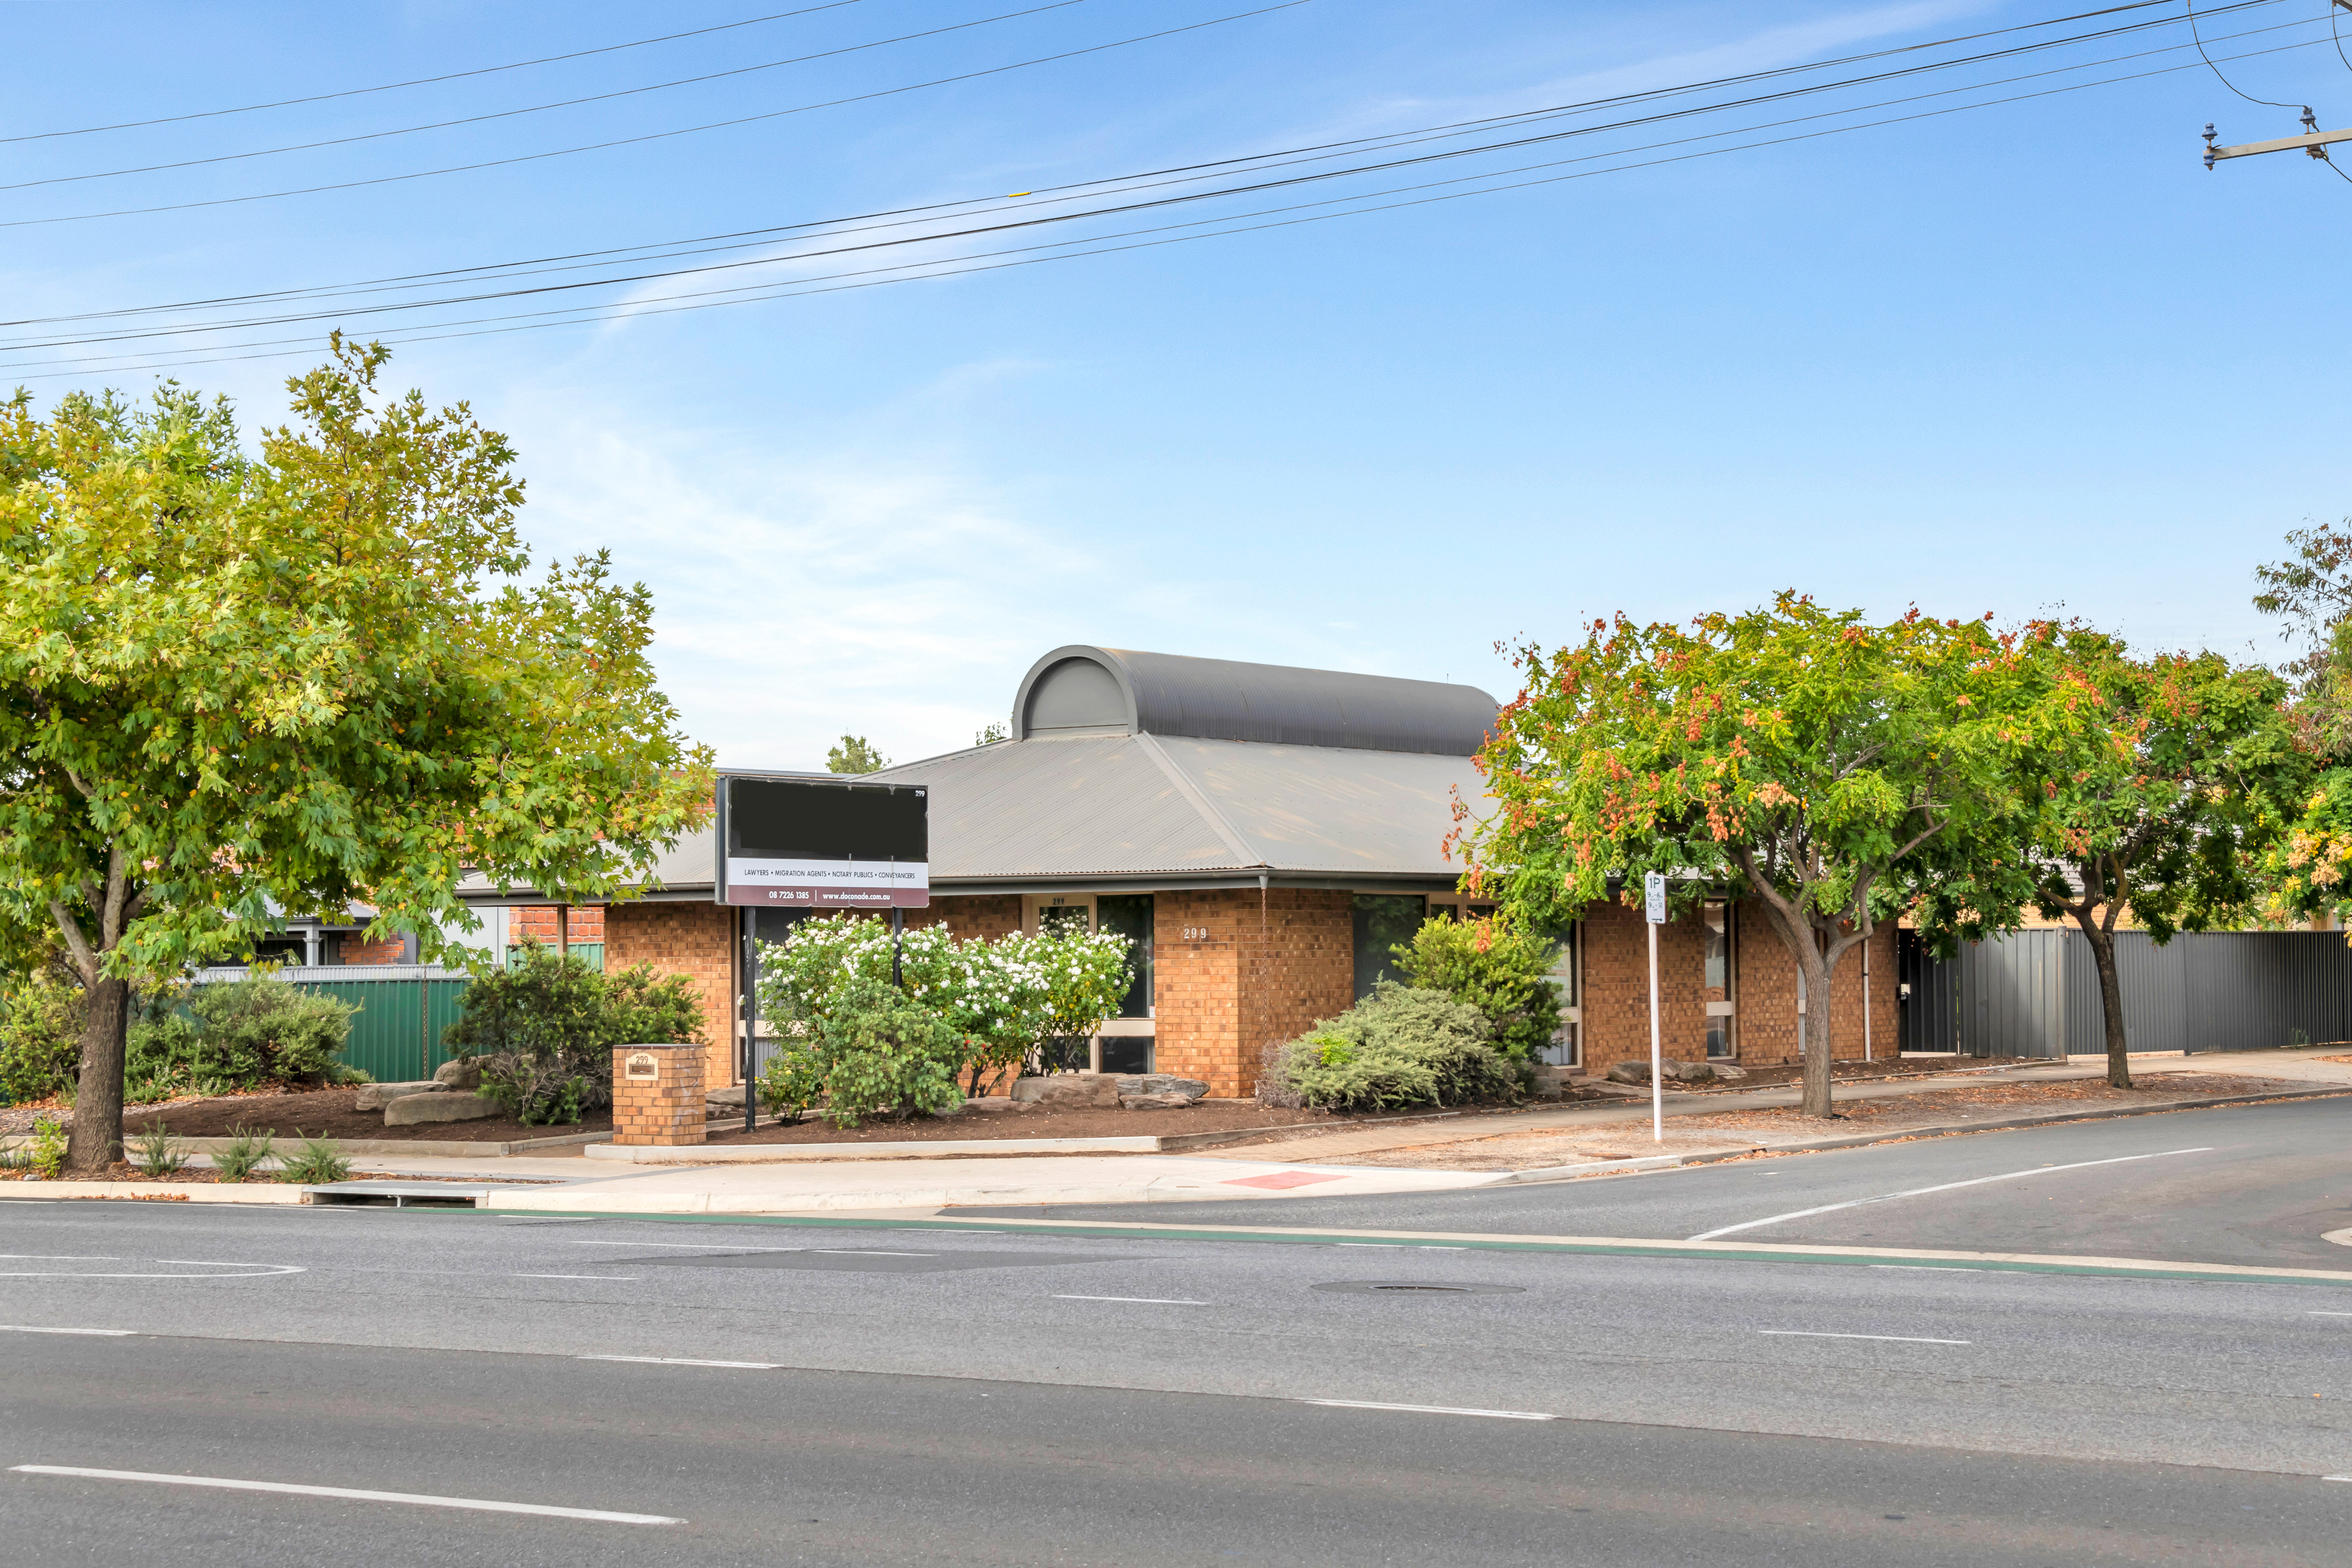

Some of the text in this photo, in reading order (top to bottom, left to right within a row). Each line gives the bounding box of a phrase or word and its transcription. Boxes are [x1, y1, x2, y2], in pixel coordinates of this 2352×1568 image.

[1649, 877, 1660, 888] 1P
[823, 891, 890, 900] www.doconade.com.au
[1184, 928, 1206, 939] 299
[636, 1056, 648, 1064] 299
